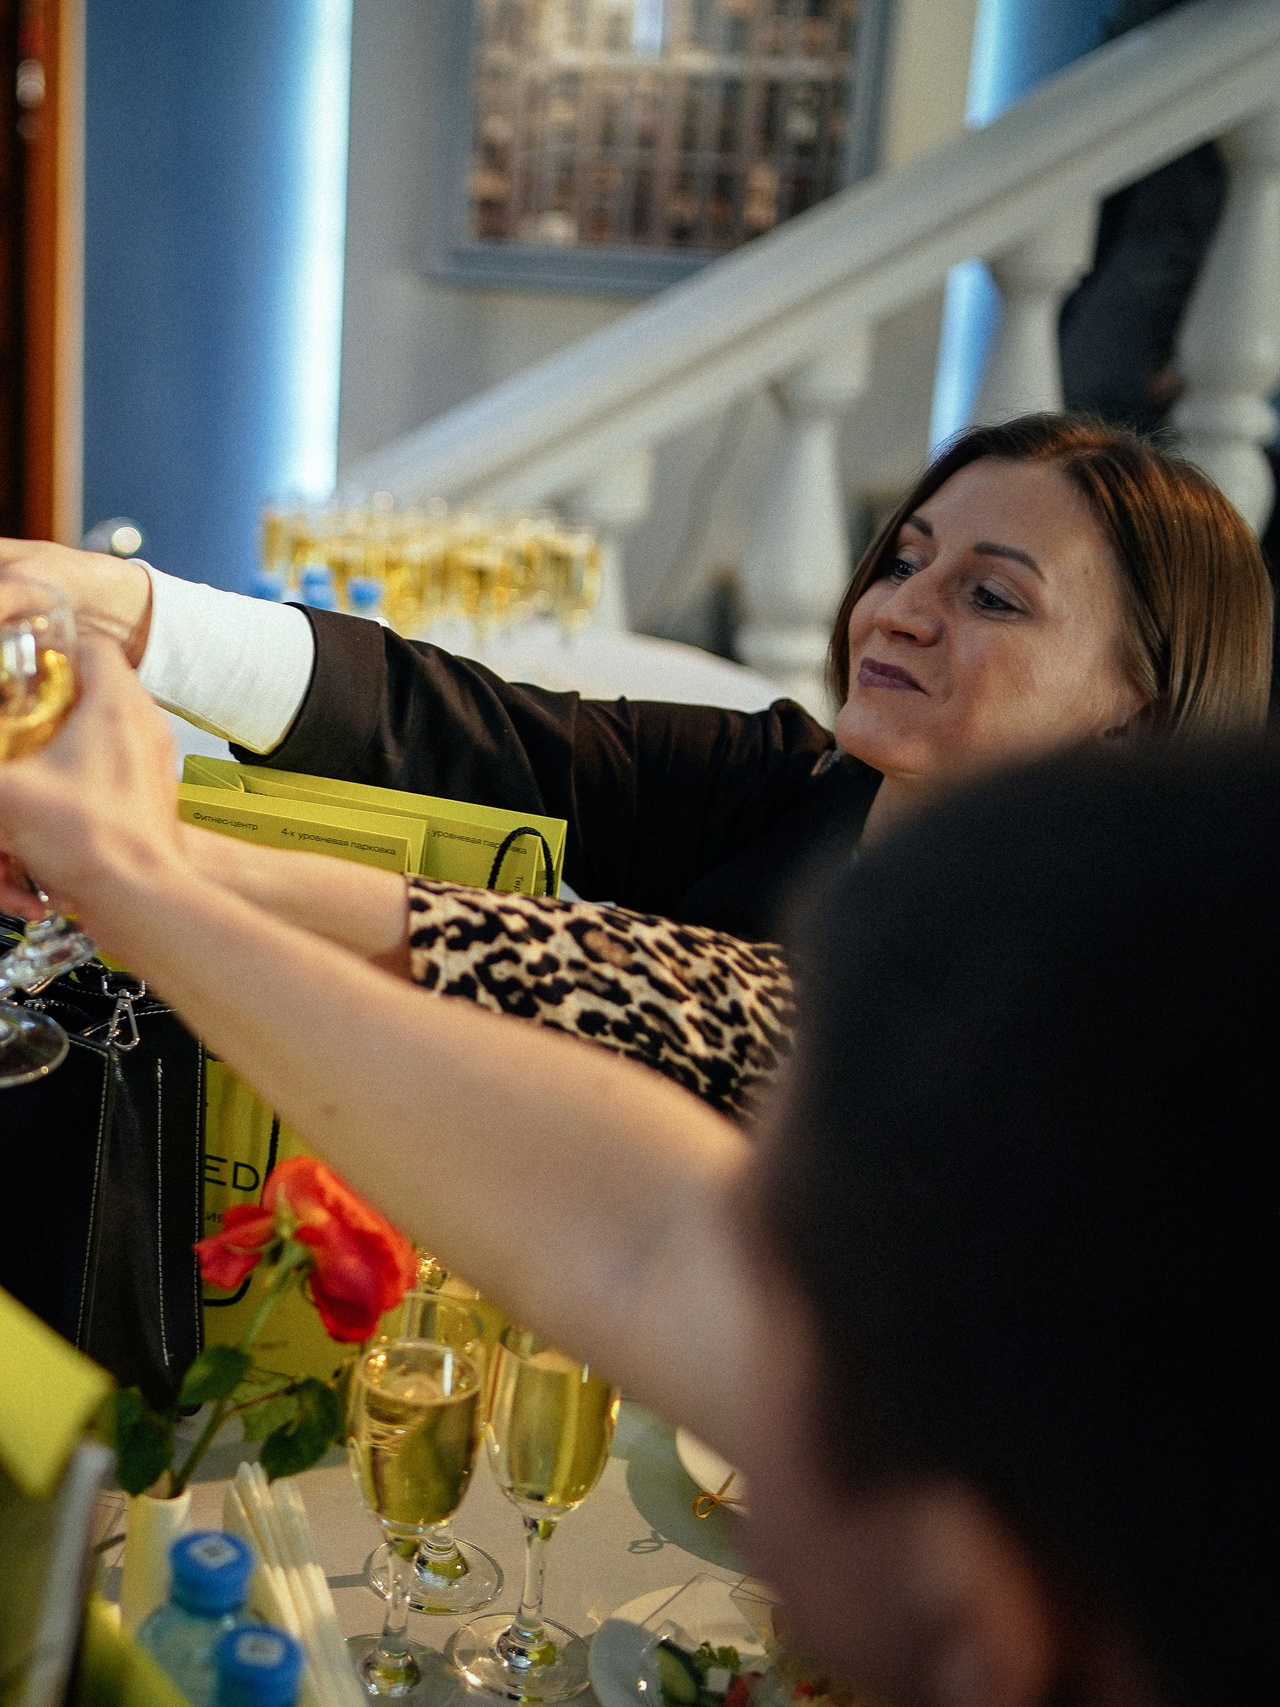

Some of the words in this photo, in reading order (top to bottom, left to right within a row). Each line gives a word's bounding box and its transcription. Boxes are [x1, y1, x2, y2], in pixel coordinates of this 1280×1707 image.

[193, 812, 259, 831] Фитнес-центр
[281, 828, 296, 838] 4-х
[298, 832, 349, 847] уровневая
[350, 841, 397, 856] парковка
[432, 829, 482, 846] уровневая
[483, 839, 528, 855] парвка
